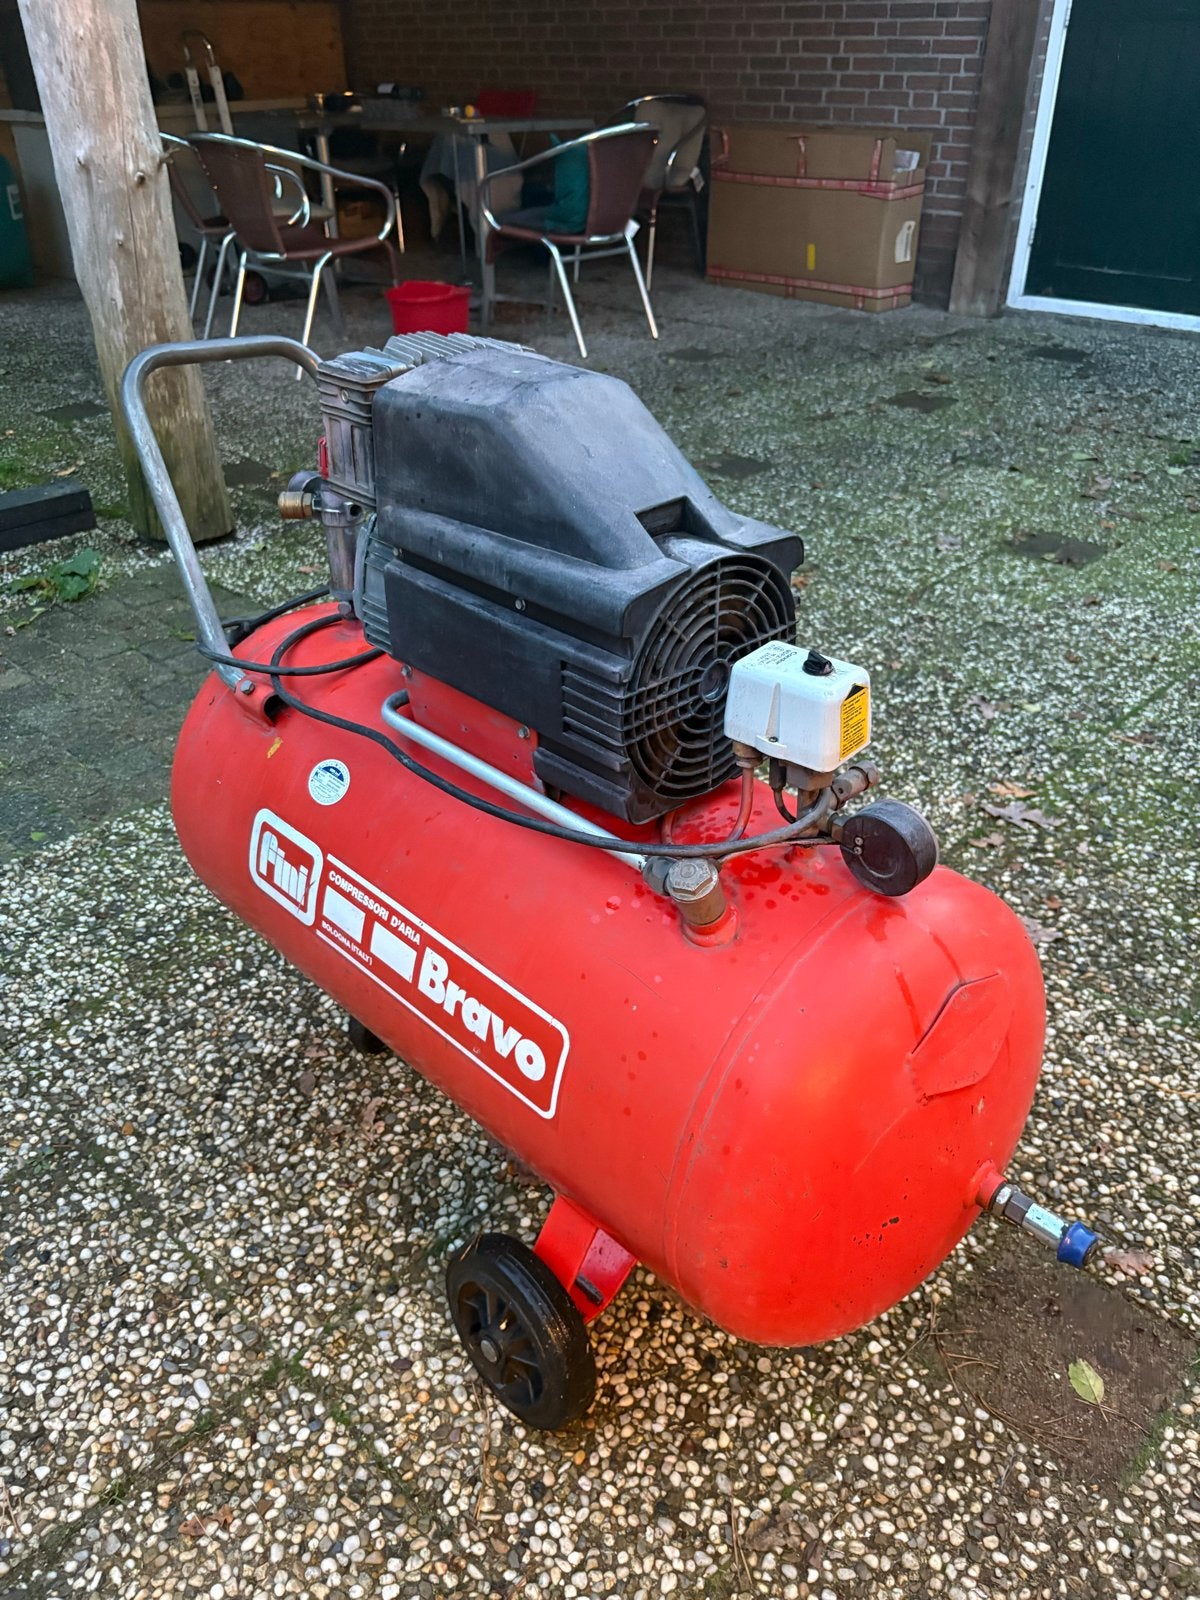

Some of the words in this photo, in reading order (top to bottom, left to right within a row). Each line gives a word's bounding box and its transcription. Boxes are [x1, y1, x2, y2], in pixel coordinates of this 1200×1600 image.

[321, 920, 351, 948] BOLOGNA
[351, 943, 373, 966] (ITALY)
[329, 870, 389, 921] COMPRESSORI
[390, 915, 421, 945] D'ARIA
[417, 946, 546, 1081] Bravo
